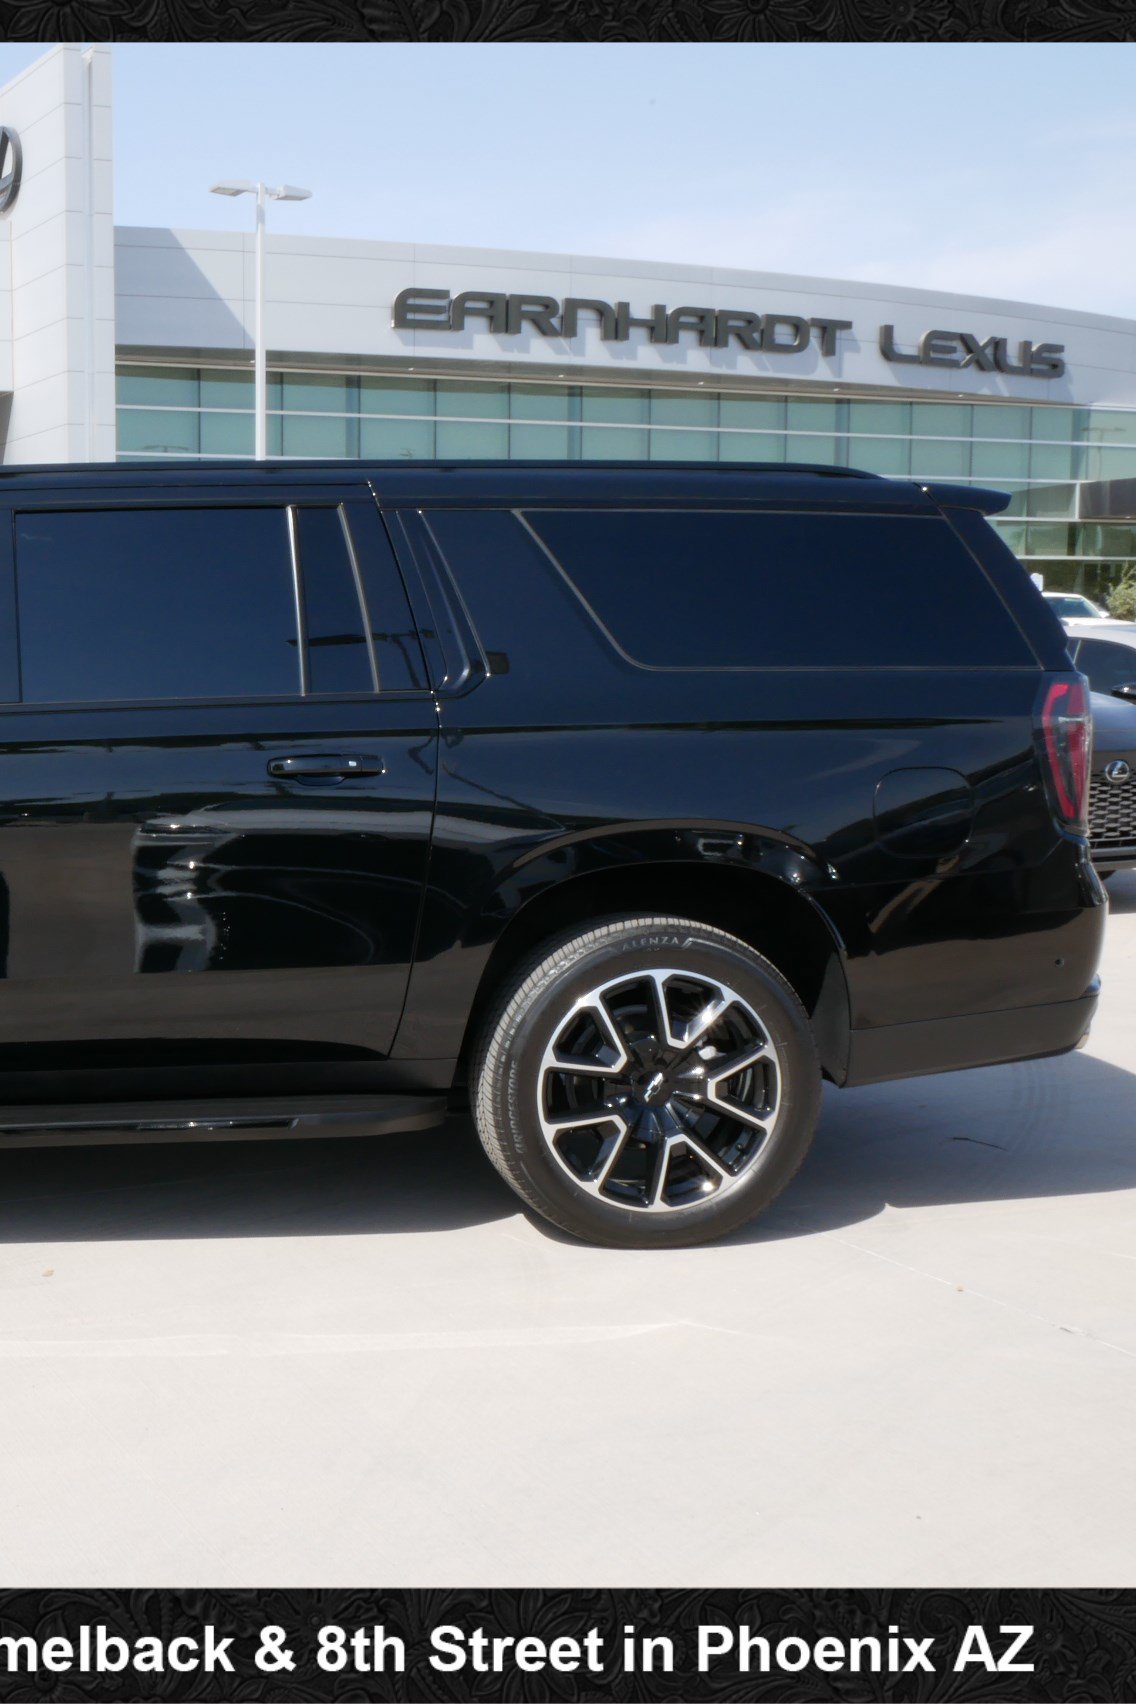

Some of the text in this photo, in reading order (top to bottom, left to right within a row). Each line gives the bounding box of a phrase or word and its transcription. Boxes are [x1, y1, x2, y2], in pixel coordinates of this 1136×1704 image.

[392, 287, 1066, 378] EARNHARDT LEXUS
[622, 936, 680, 951] ALENZA
